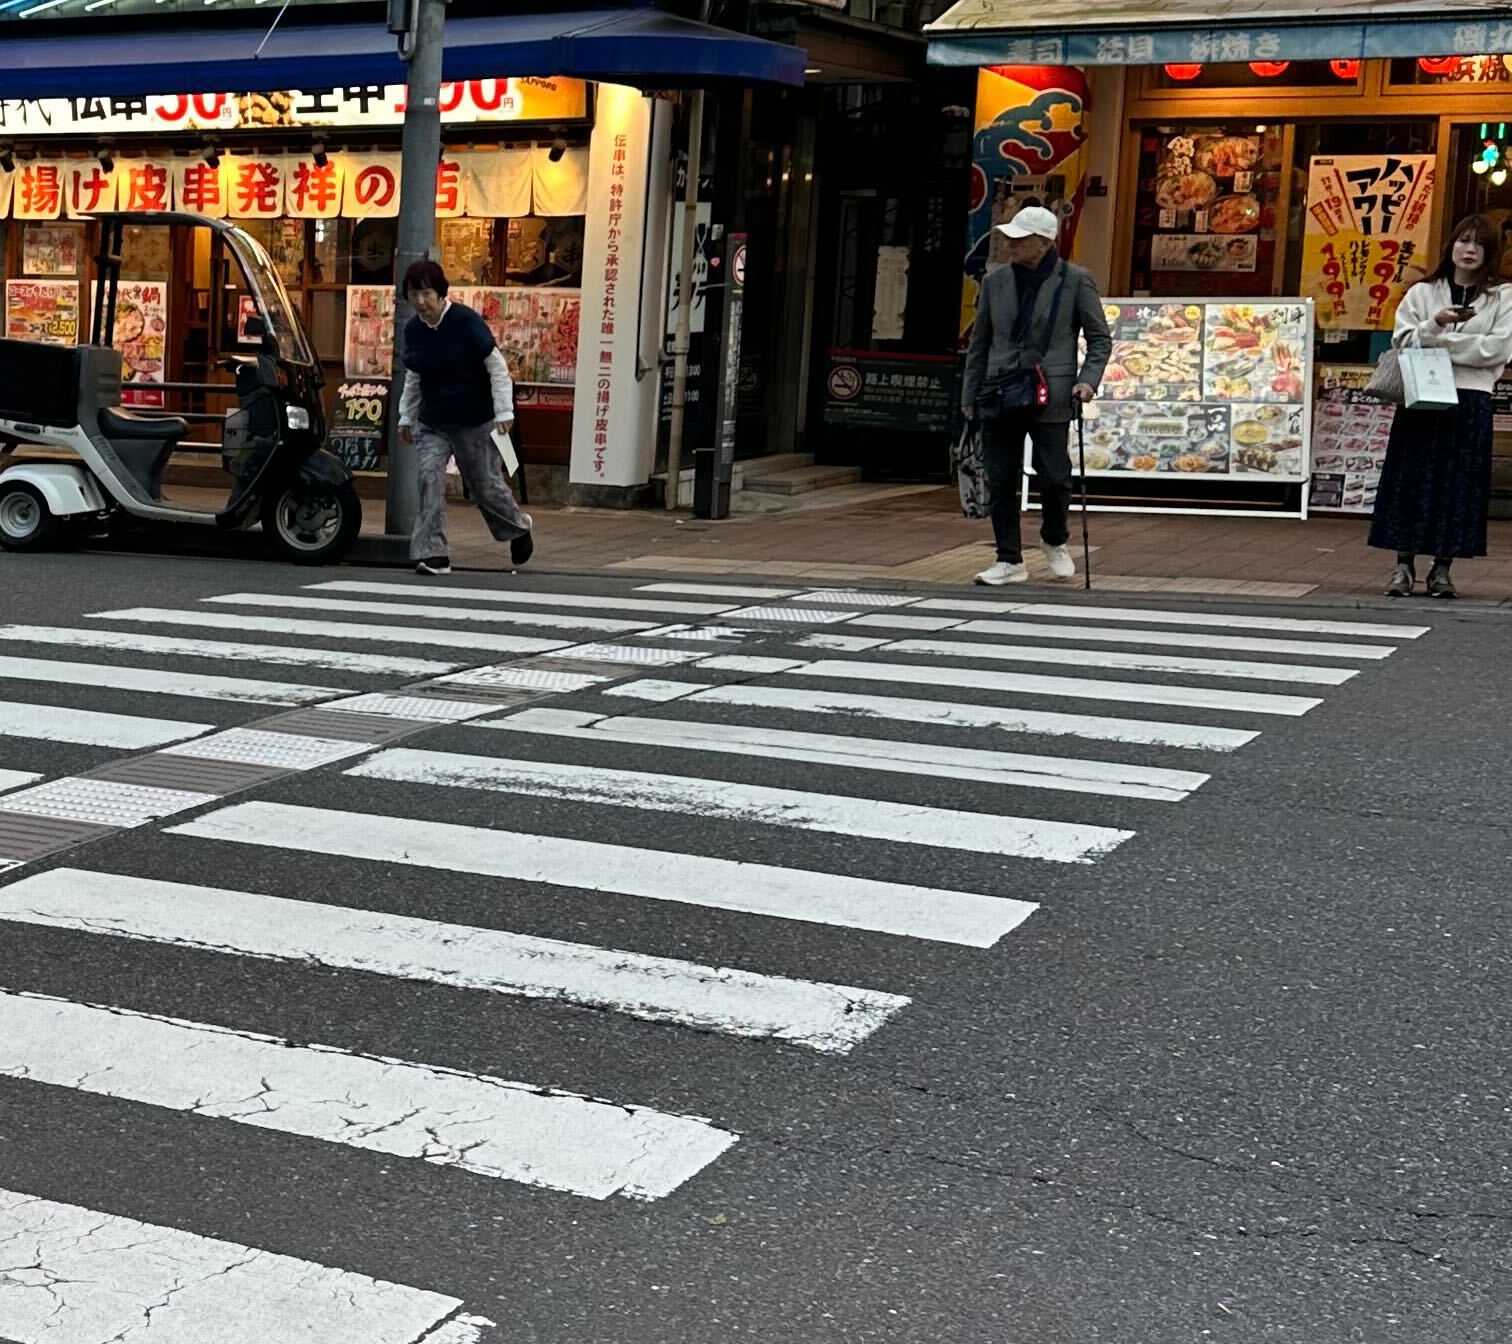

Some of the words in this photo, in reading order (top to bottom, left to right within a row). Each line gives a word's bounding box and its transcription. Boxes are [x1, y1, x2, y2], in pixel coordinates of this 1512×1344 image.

[1346, 167, 1381, 236] アワー
[1391, 240, 1416, 284] 生ビール
[345, 398, 383, 422] 190
